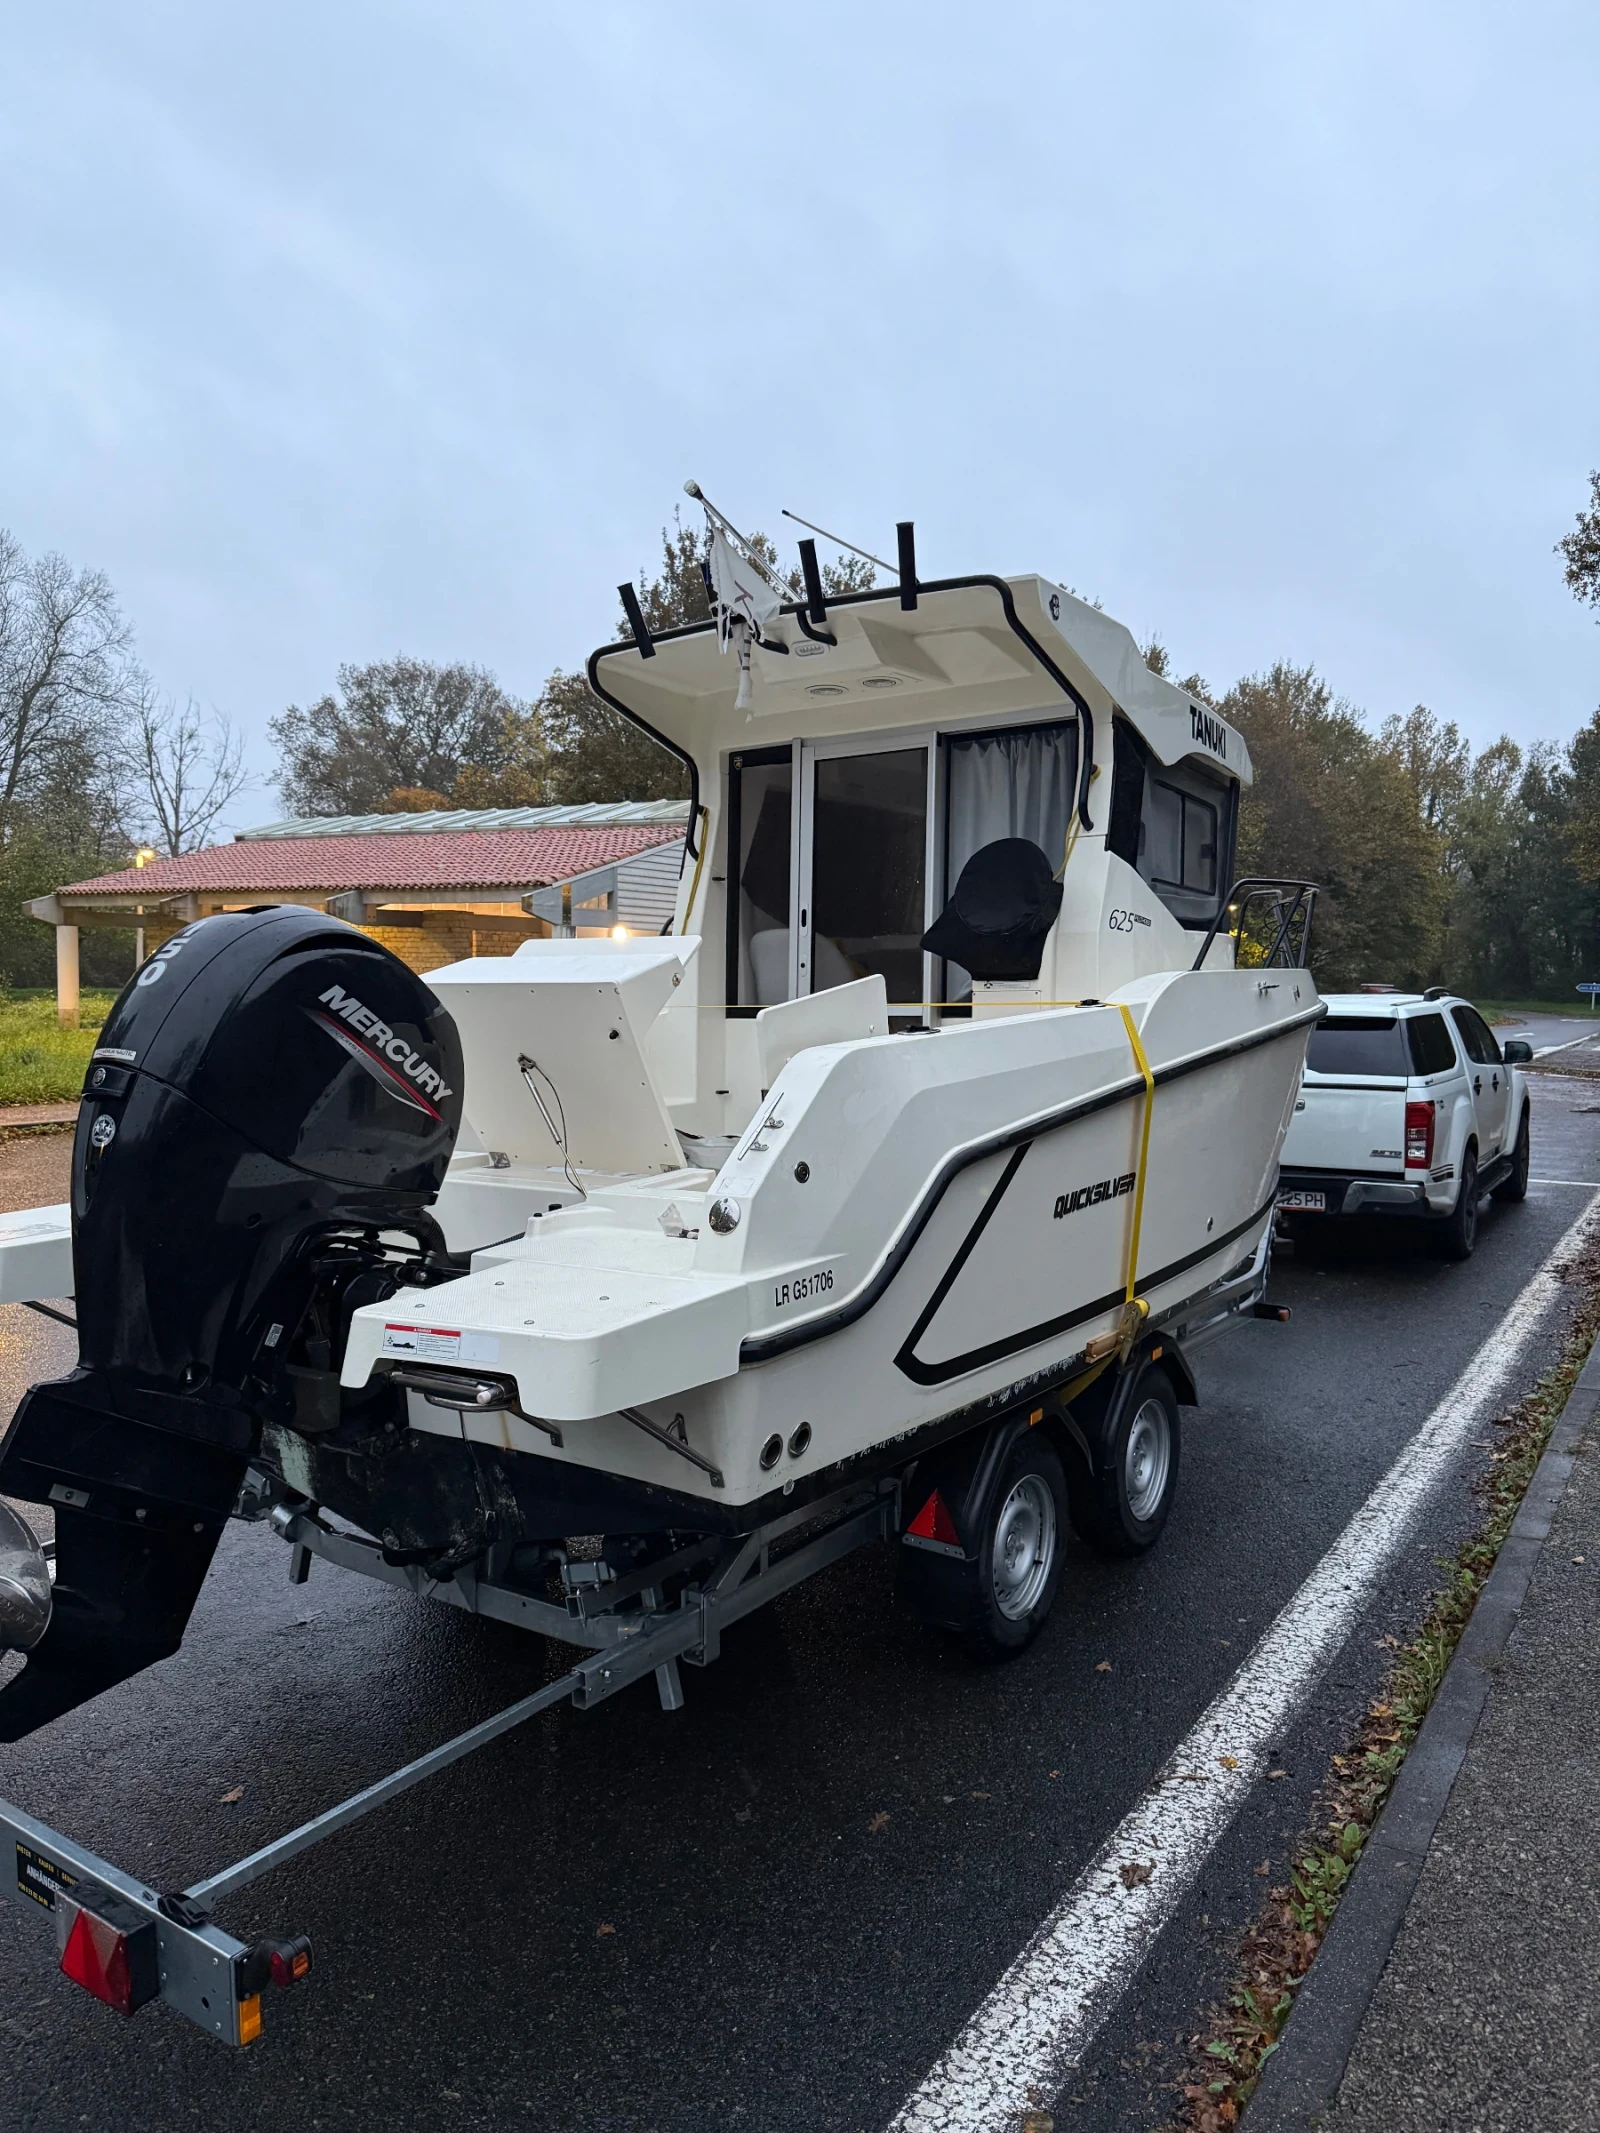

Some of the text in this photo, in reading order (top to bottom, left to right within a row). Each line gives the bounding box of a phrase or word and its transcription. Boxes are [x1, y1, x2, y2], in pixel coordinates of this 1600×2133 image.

[1190, 704, 1226, 760] TANUKI
[1109, 909, 1134, 933] 625
[138, 921, 208, 987] 150
[318, 984, 453, 1102] MERCURY
[1053, 1171, 1137, 1219] QUICKSILVER
[1305, 1193, 1323, 1207] PH
[775, 1269, 834, 1307] LR G51706
